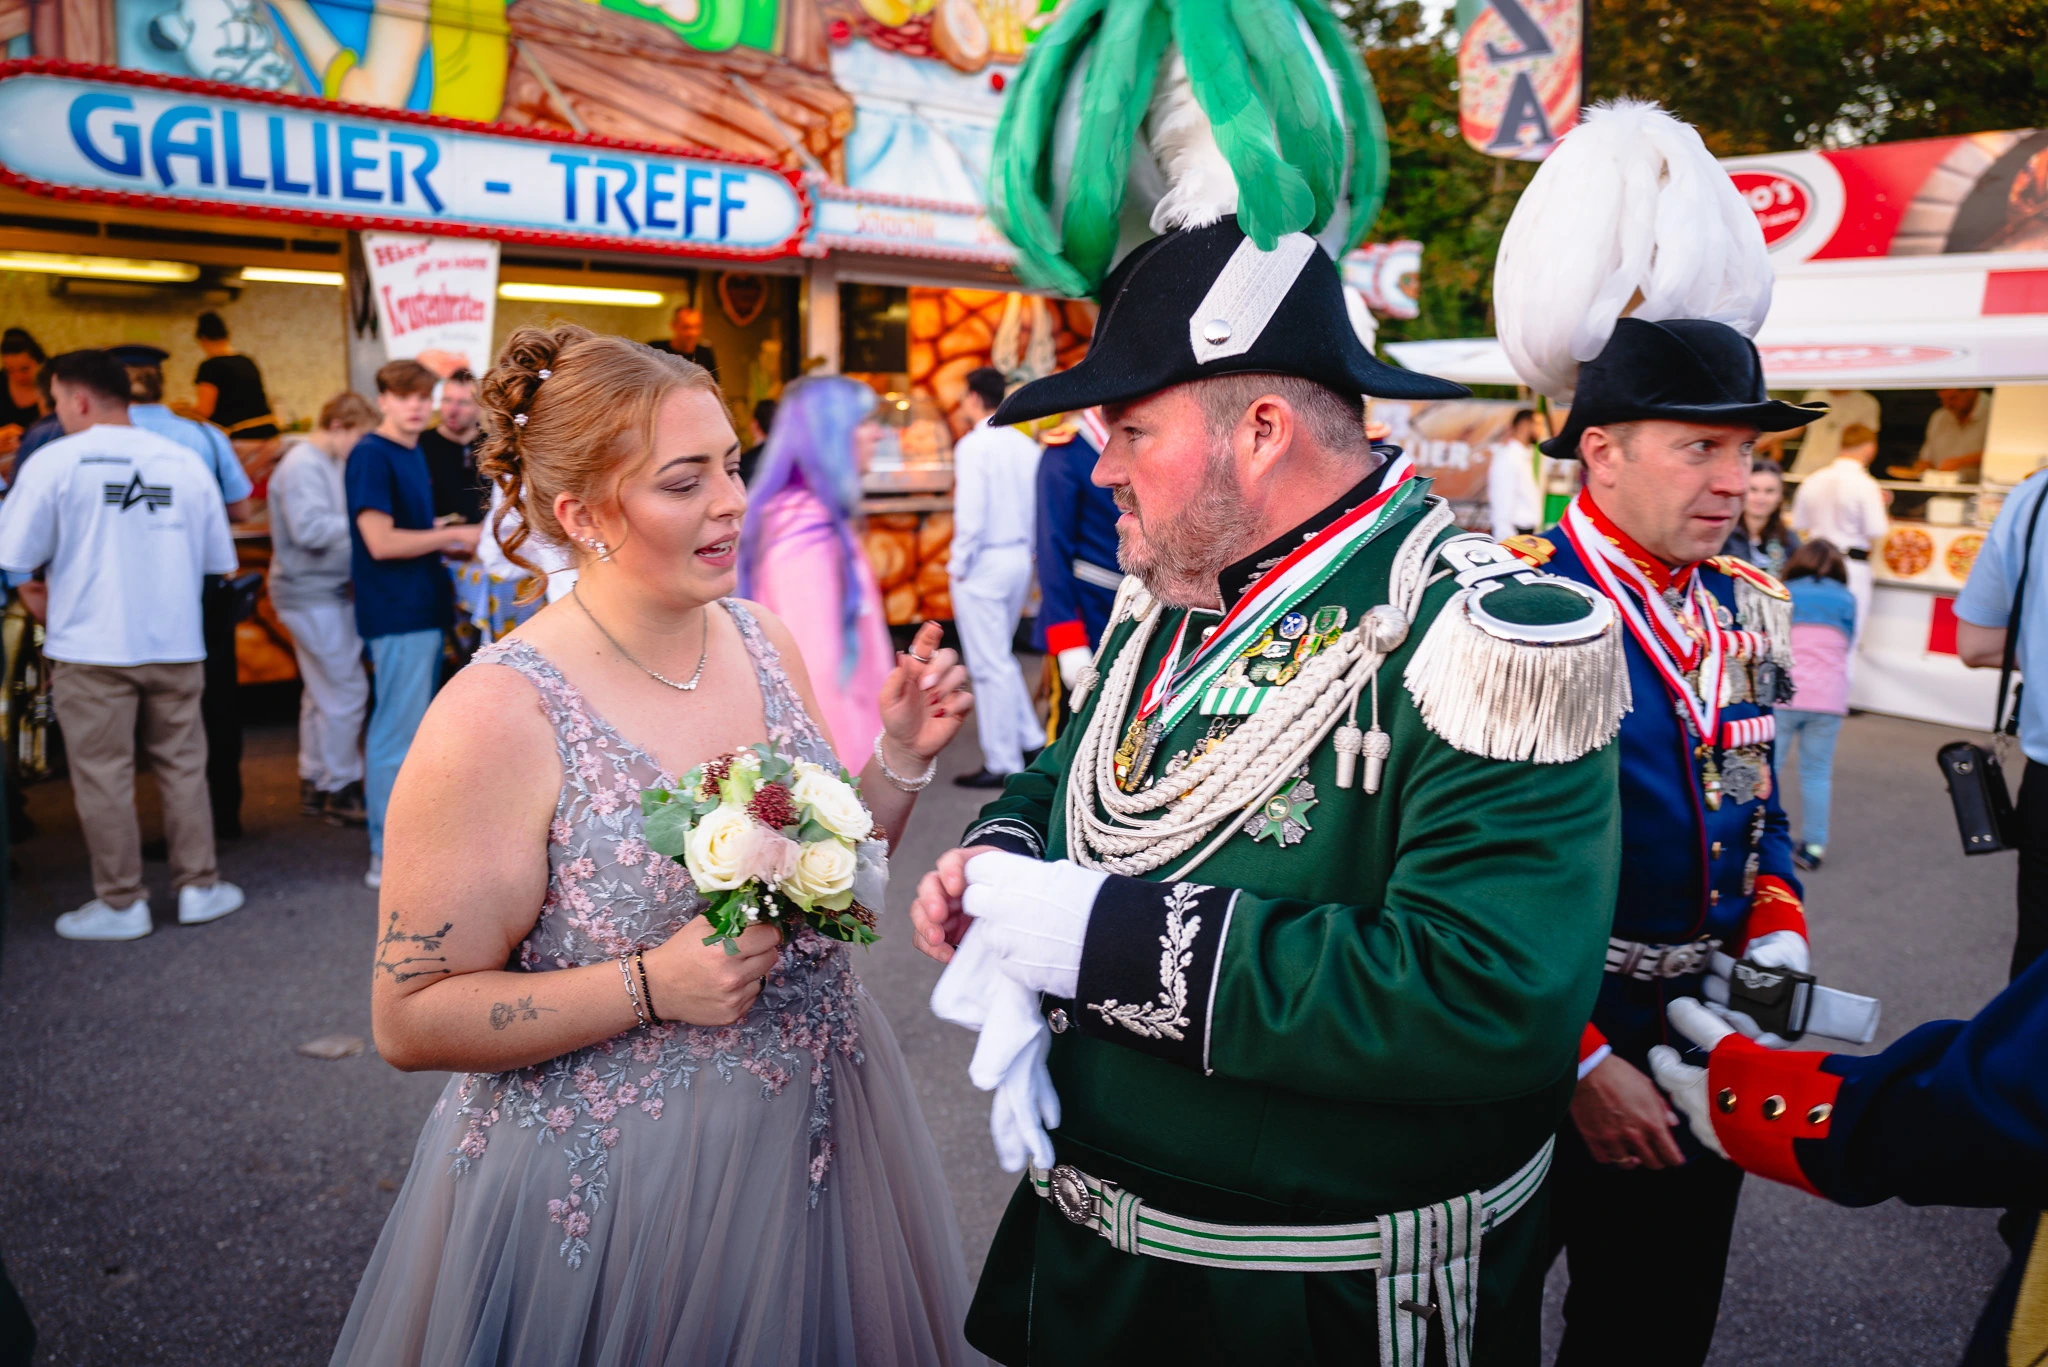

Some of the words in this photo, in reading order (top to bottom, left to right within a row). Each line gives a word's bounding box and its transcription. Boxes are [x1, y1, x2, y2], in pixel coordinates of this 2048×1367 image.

[68, 93, 444, 214] GALLIER
[485, 181, 511, 194] -
[549, 153, 747, 240] TREFF
